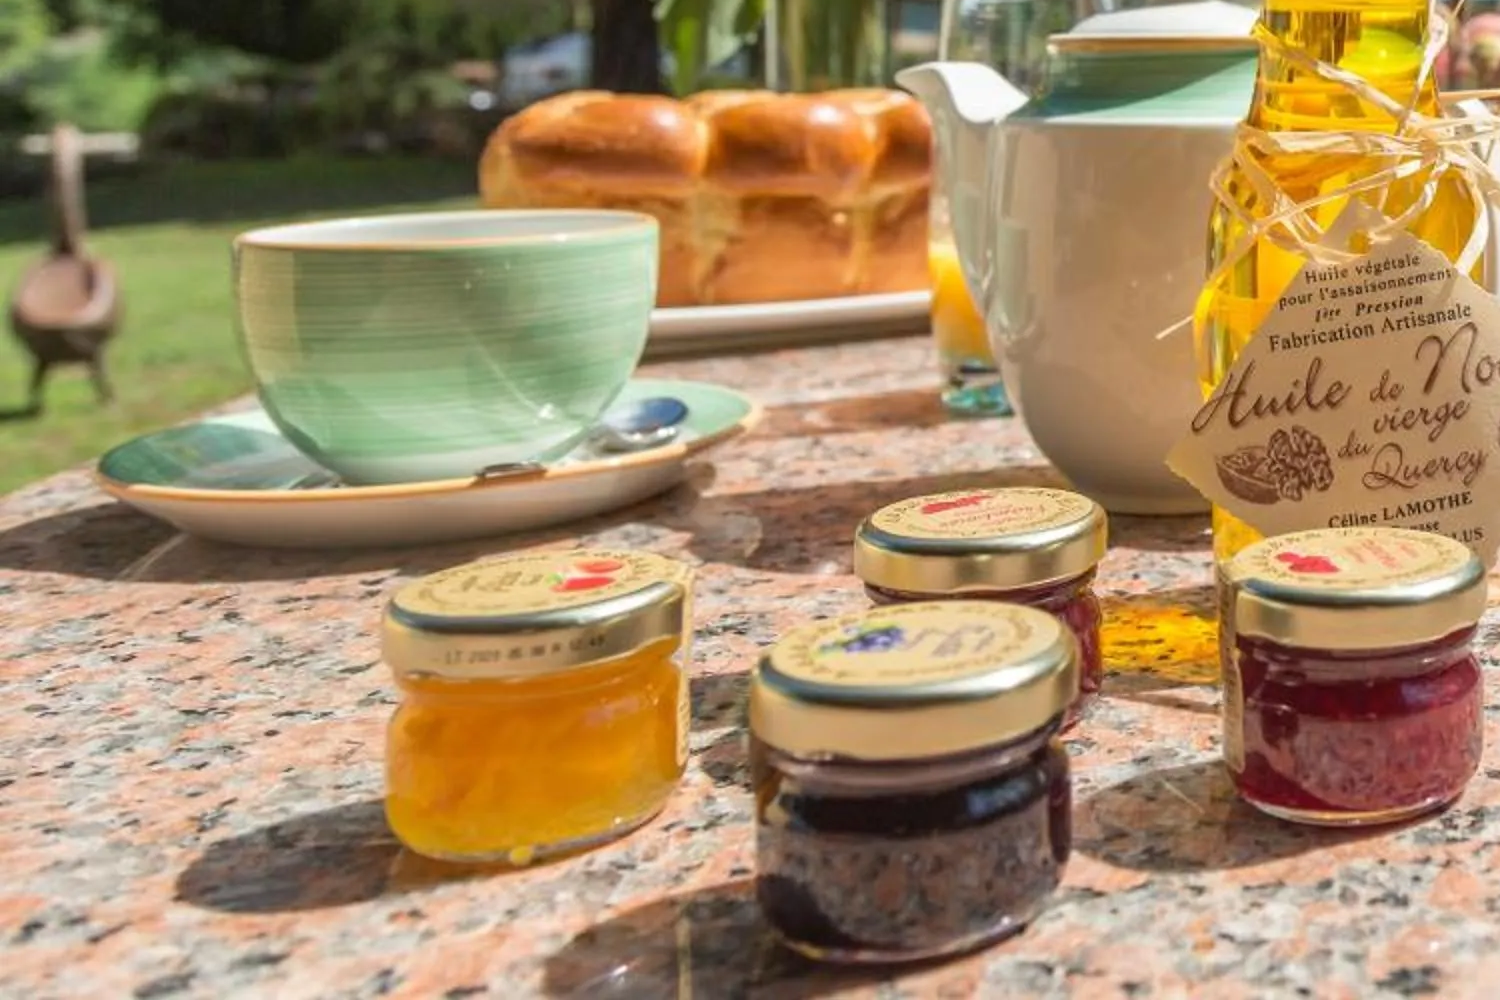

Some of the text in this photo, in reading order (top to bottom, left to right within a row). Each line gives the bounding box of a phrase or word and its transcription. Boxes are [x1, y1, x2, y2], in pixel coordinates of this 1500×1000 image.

[1278, 268, 1453, 311] pour l'assaisonnement
[1305, 254, 1421, 285] Huile végétale
[1269, 303, 1472, 352] Fabrication Artisanale
[1355, 295, 1424, 317] Pression
[1191, 356, 1352, 433] Huile
[1369, 369, 1404, 402] de
[1373, 399, 1470, 442] vierge
[1337, 430, 1489, 490] du Quercy
[1328, 509, 1377, 528] Céline
[1383, 490, 1474, 521] LAMOTHE
